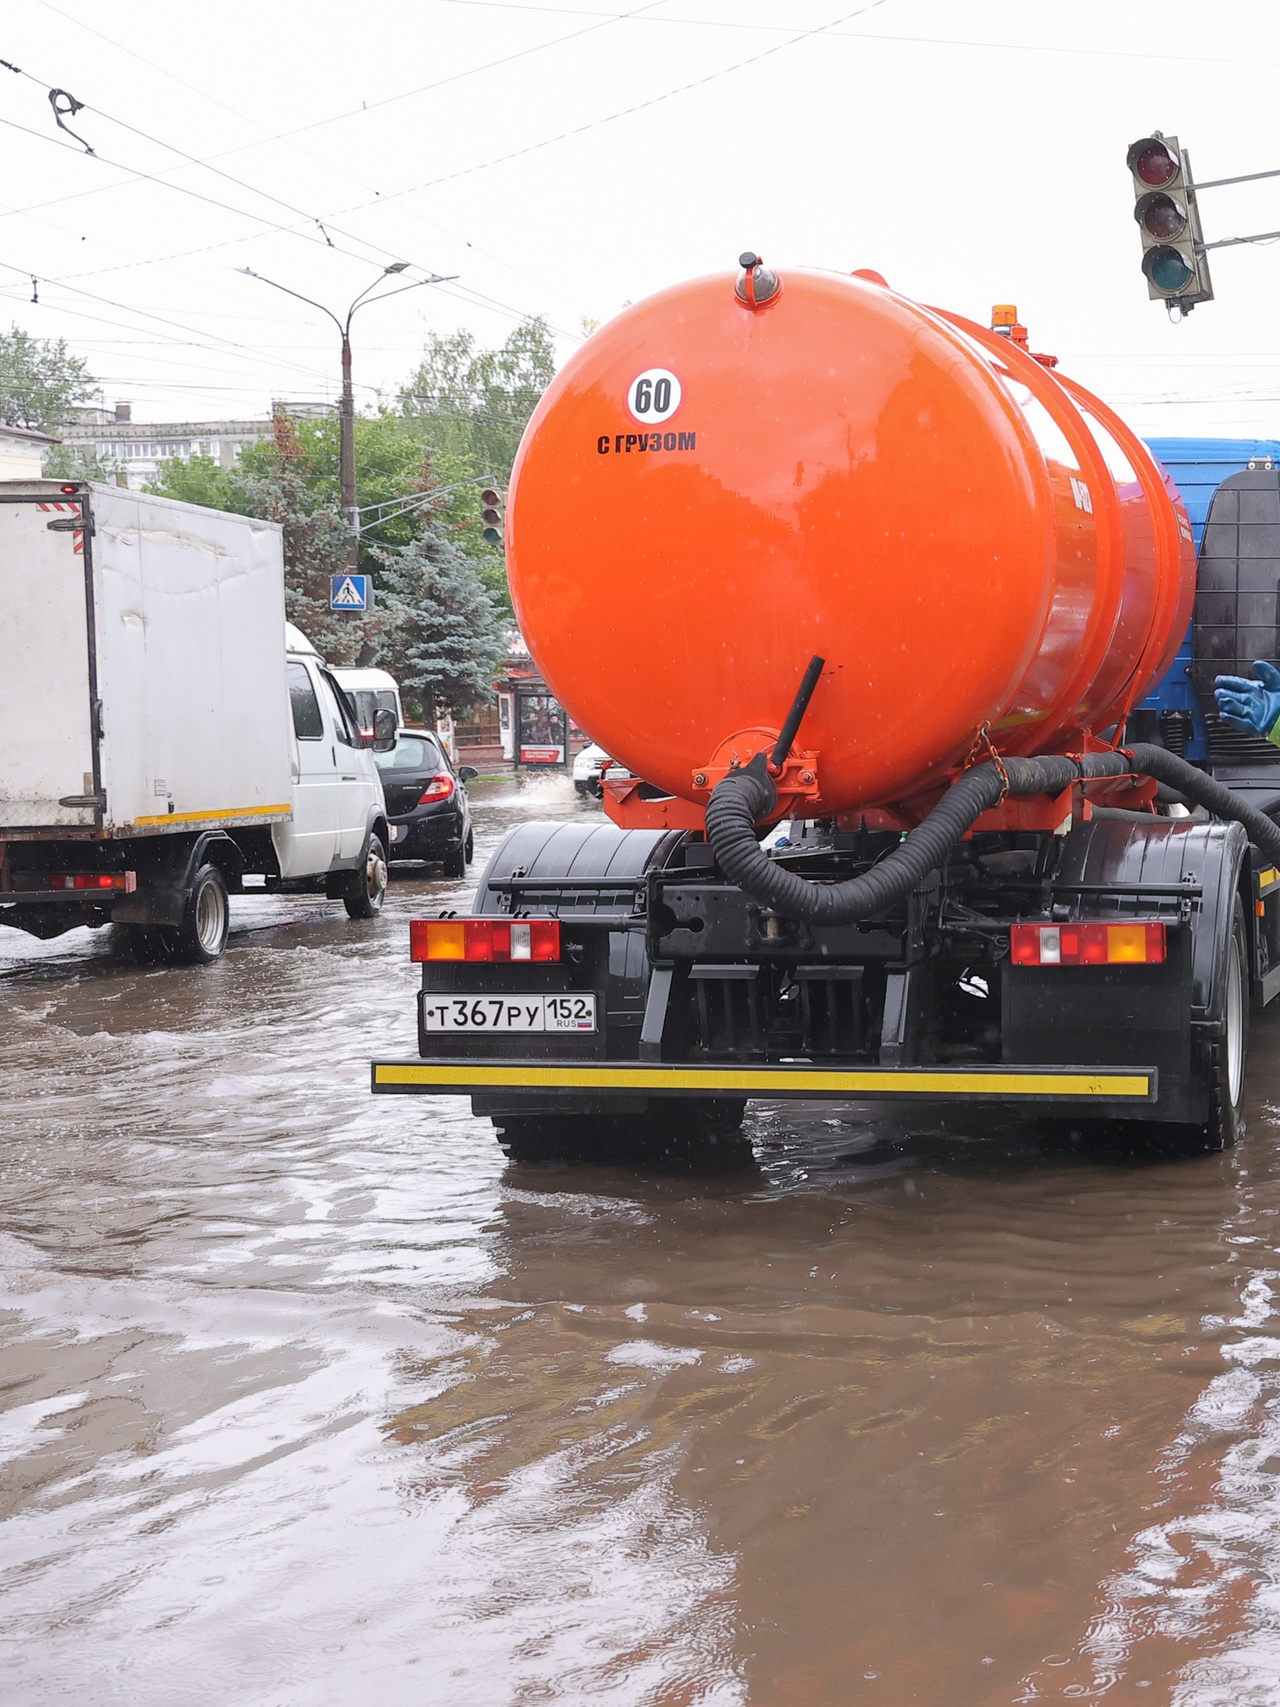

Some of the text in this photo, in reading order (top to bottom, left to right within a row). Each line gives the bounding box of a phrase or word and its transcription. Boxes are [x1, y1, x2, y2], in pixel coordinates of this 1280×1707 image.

[635, 378, 671, 414] 60
[597, 432, 696, 454] С ГРУЗОМ
[547, 999, 587, 1019] 152
[556, 1020, 577, 1028] RUS
